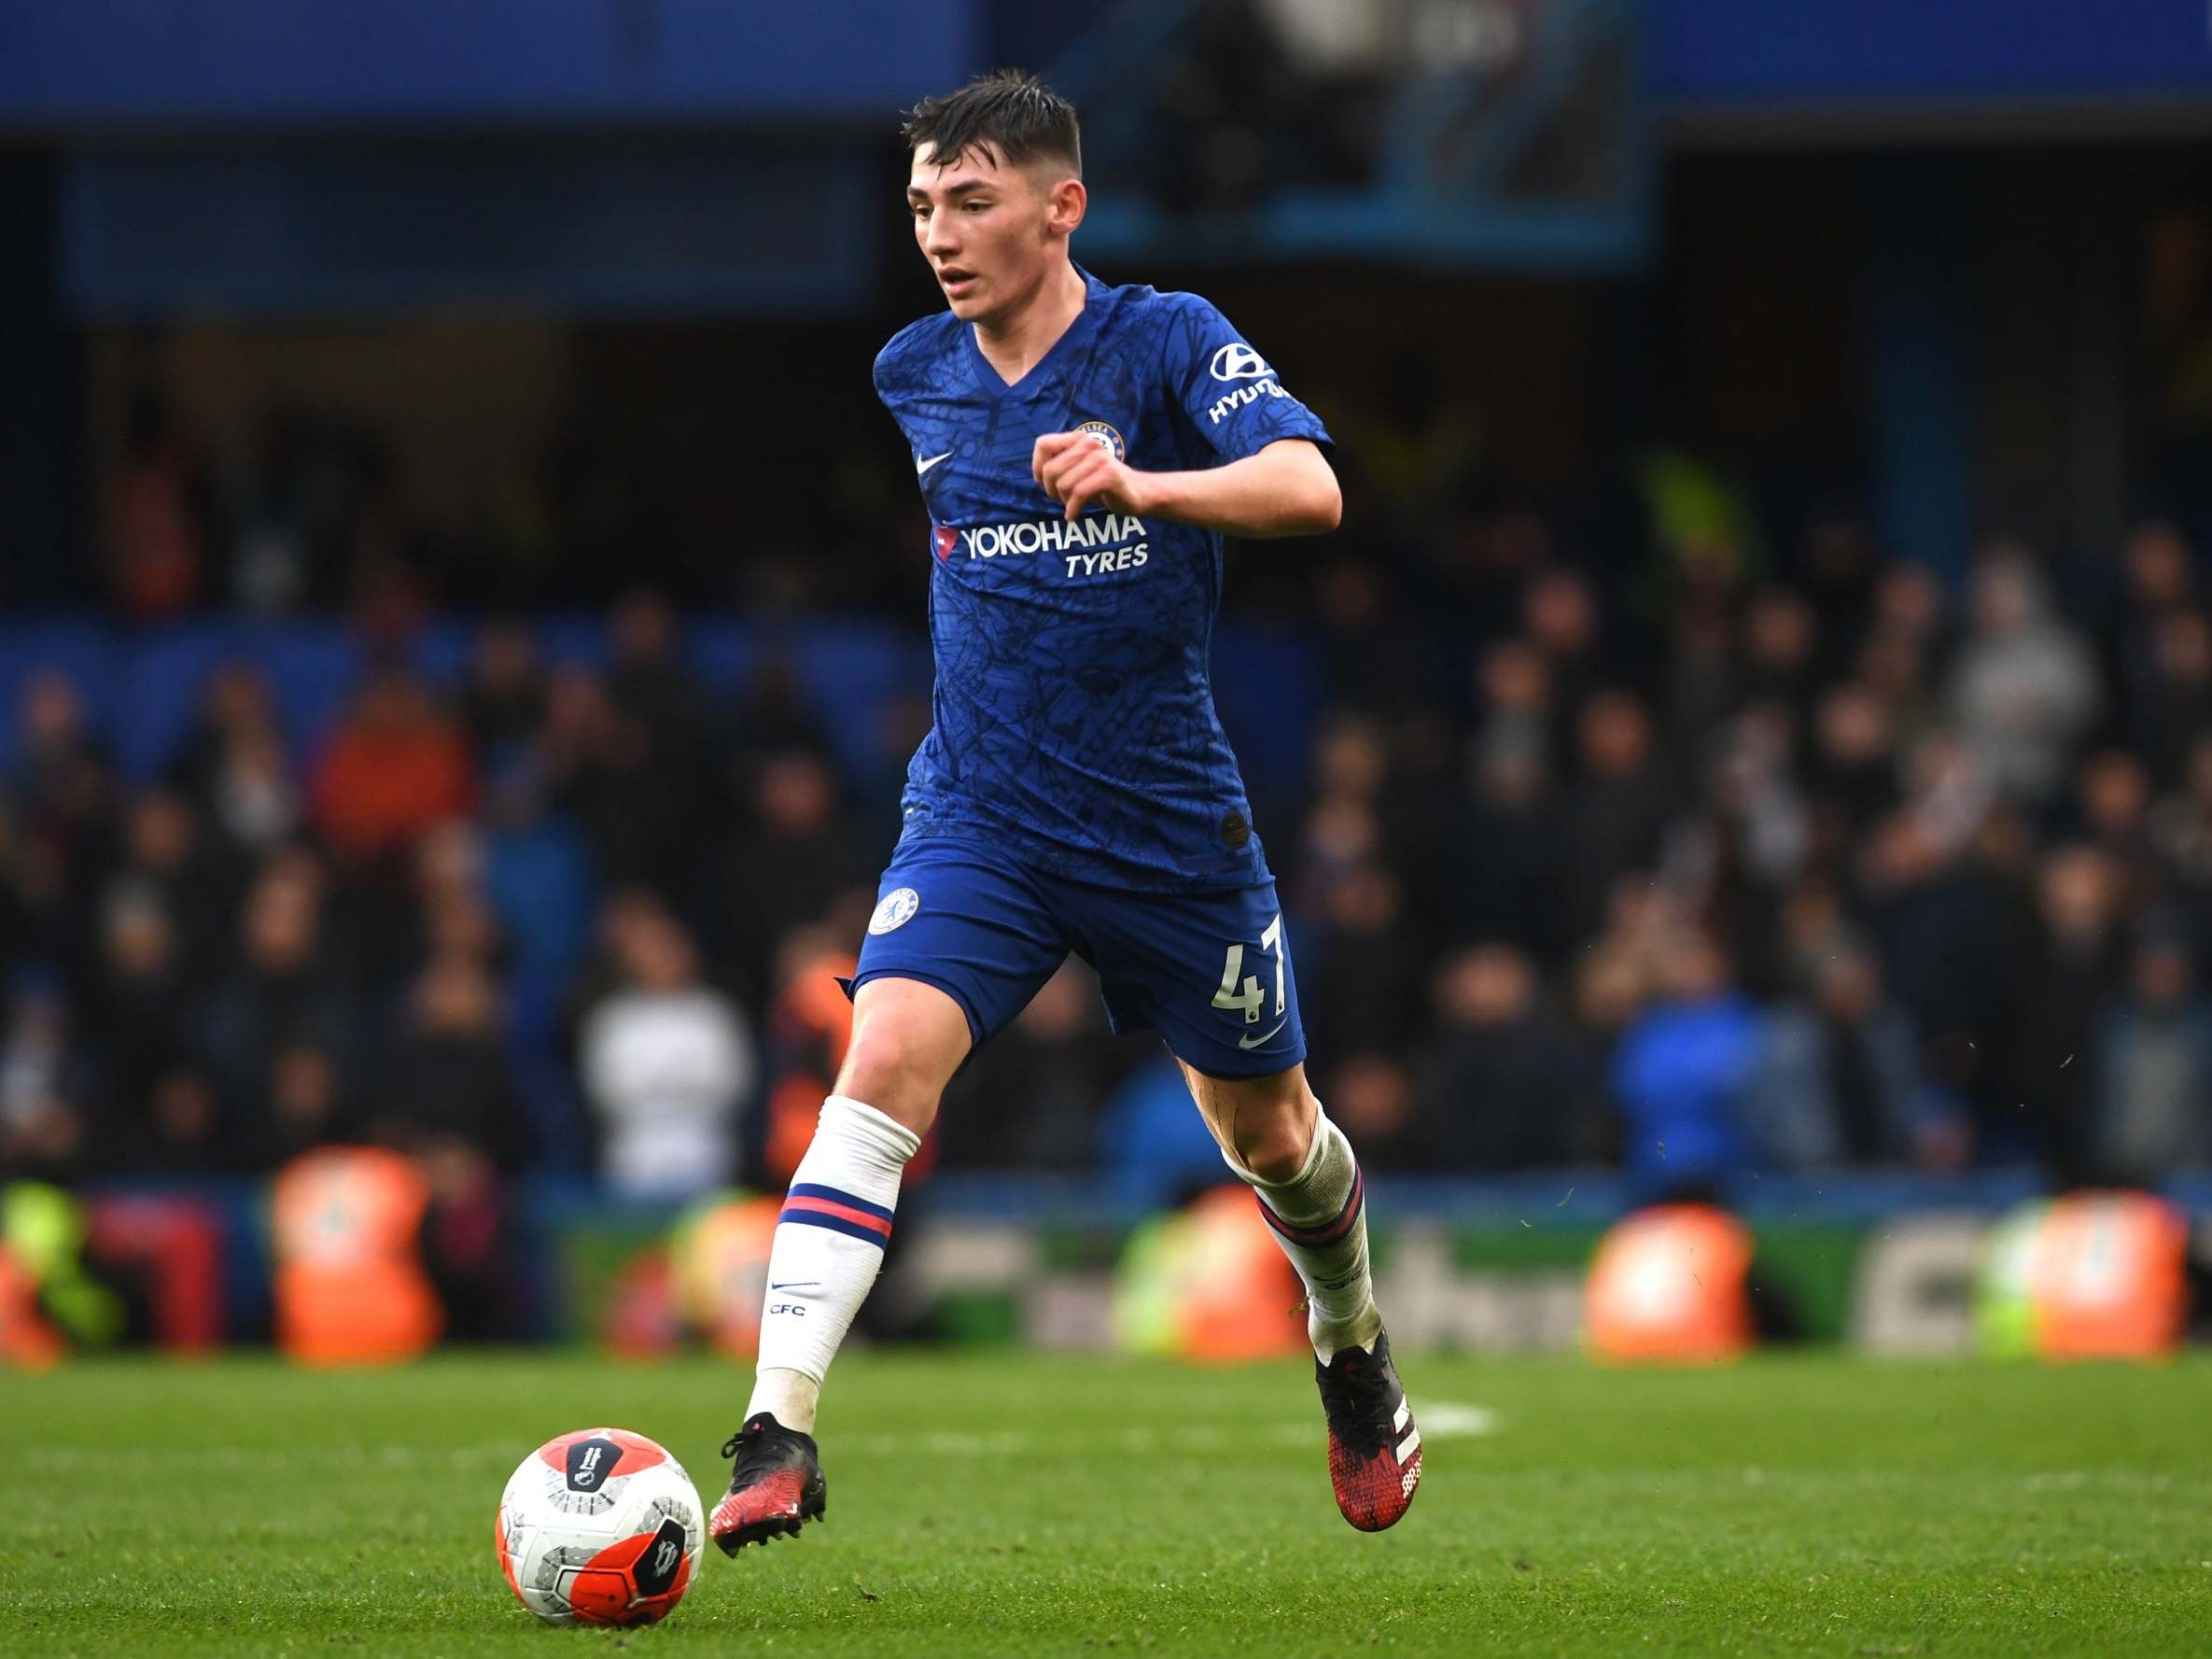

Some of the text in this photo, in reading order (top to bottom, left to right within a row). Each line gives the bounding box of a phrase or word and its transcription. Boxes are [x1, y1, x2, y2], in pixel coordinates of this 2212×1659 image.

[960, 514, 1146, 559] YOKOHAMA
[1065, 543, 1148, 578] TYRES
[1211, 913, 1285, 1024] 41
[770, 1304, 805, 1316] CFC
